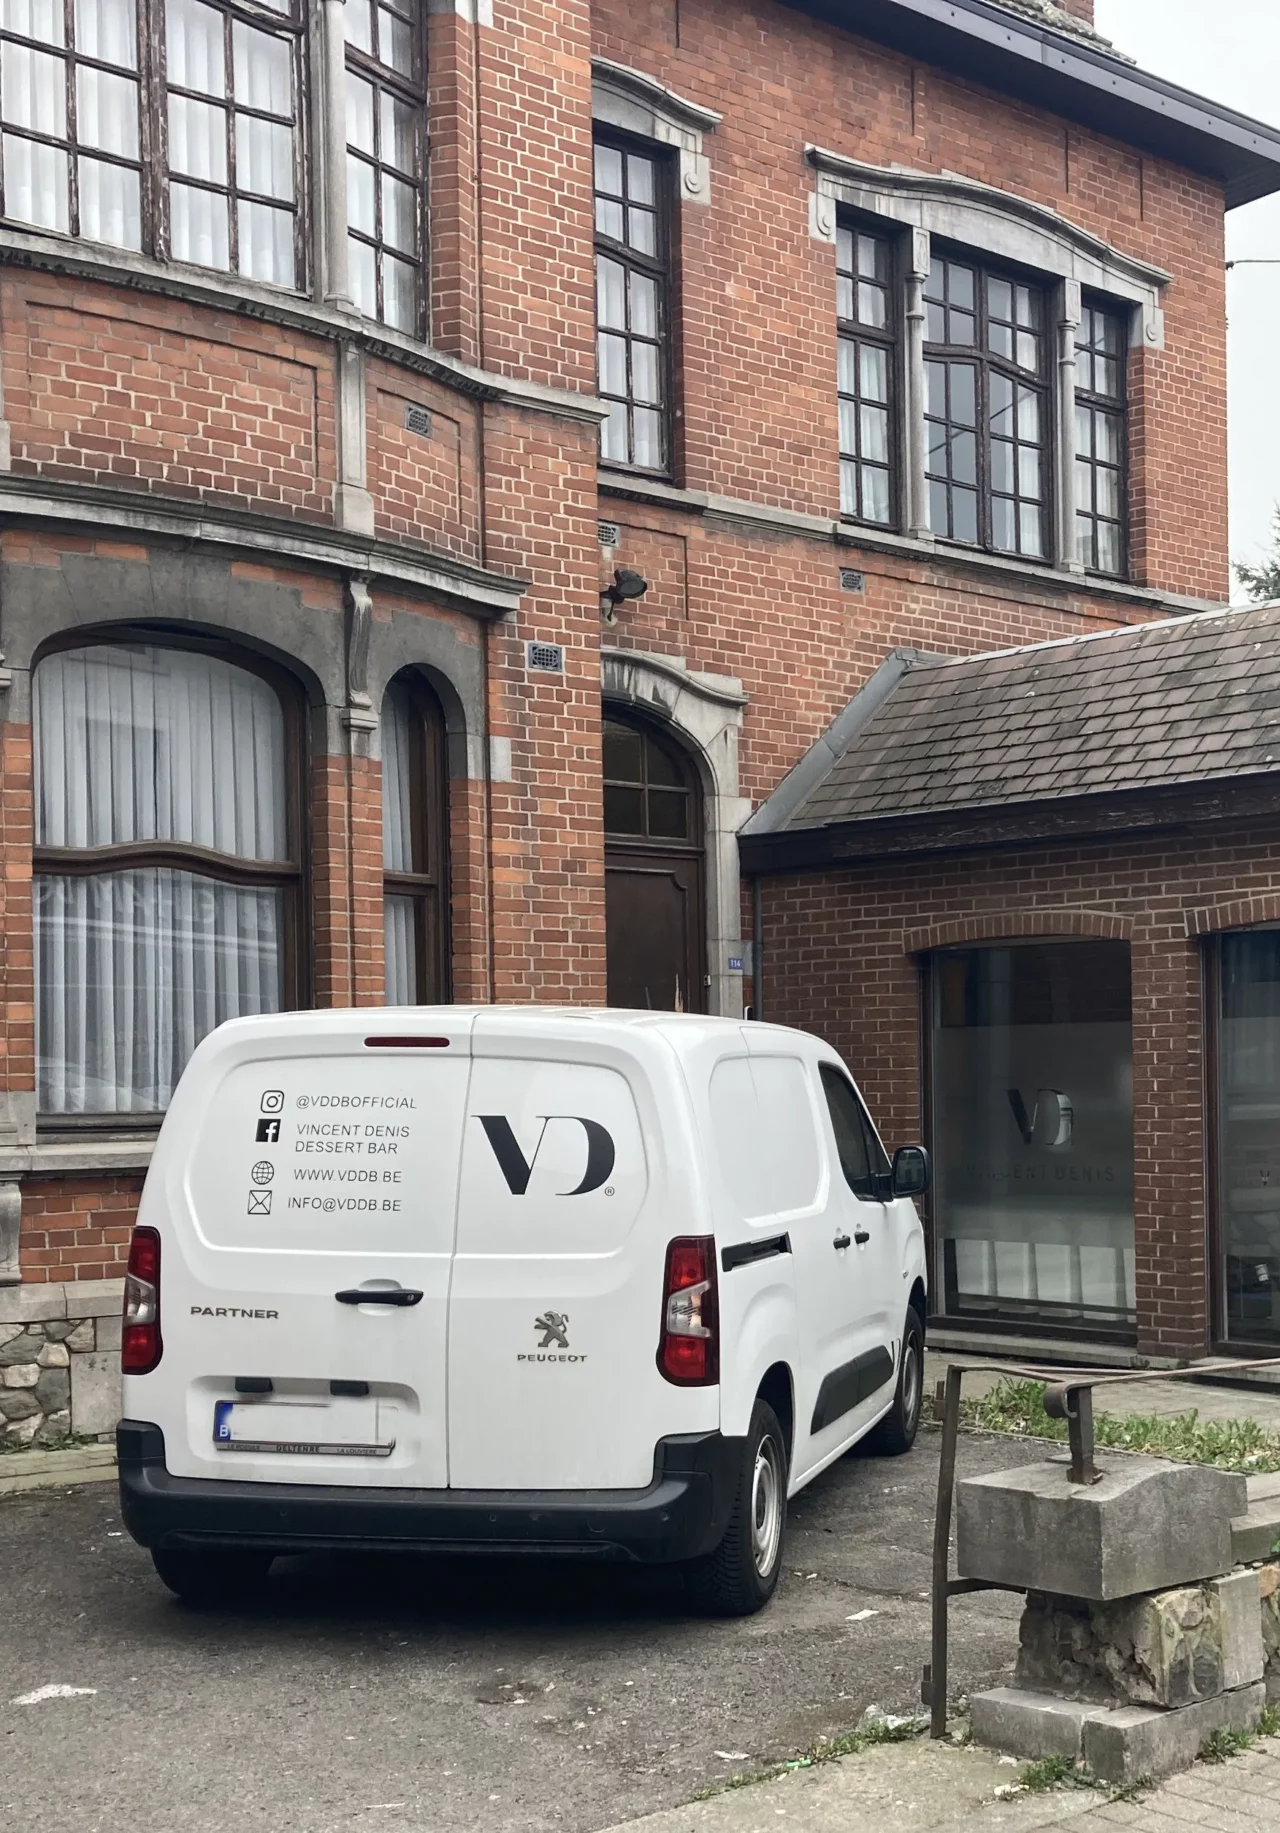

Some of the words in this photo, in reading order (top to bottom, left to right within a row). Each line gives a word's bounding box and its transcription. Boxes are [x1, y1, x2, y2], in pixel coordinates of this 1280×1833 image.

[730, 959, 741, 967] 114
[295, 1095, 417, 1109] @VDDBOFFICIAL
[297, 1124, 361, 1136] VINCENT
[364, 1125, 410, 1137] DENIS
[295, 1140, 364, 1153] DESSERT
[367, 1142, 398, 1154] BAR
[293, 1168, 402, 1183] WWW.VDDB.BE
[287, 1197, 402, 1212] INFO@VDDB.BE
[190, 1306, 279, 1319] PARTNER
[517, 1353, 588, 1362] PEUGEOT
[219, 1424, 229, 1437] B
